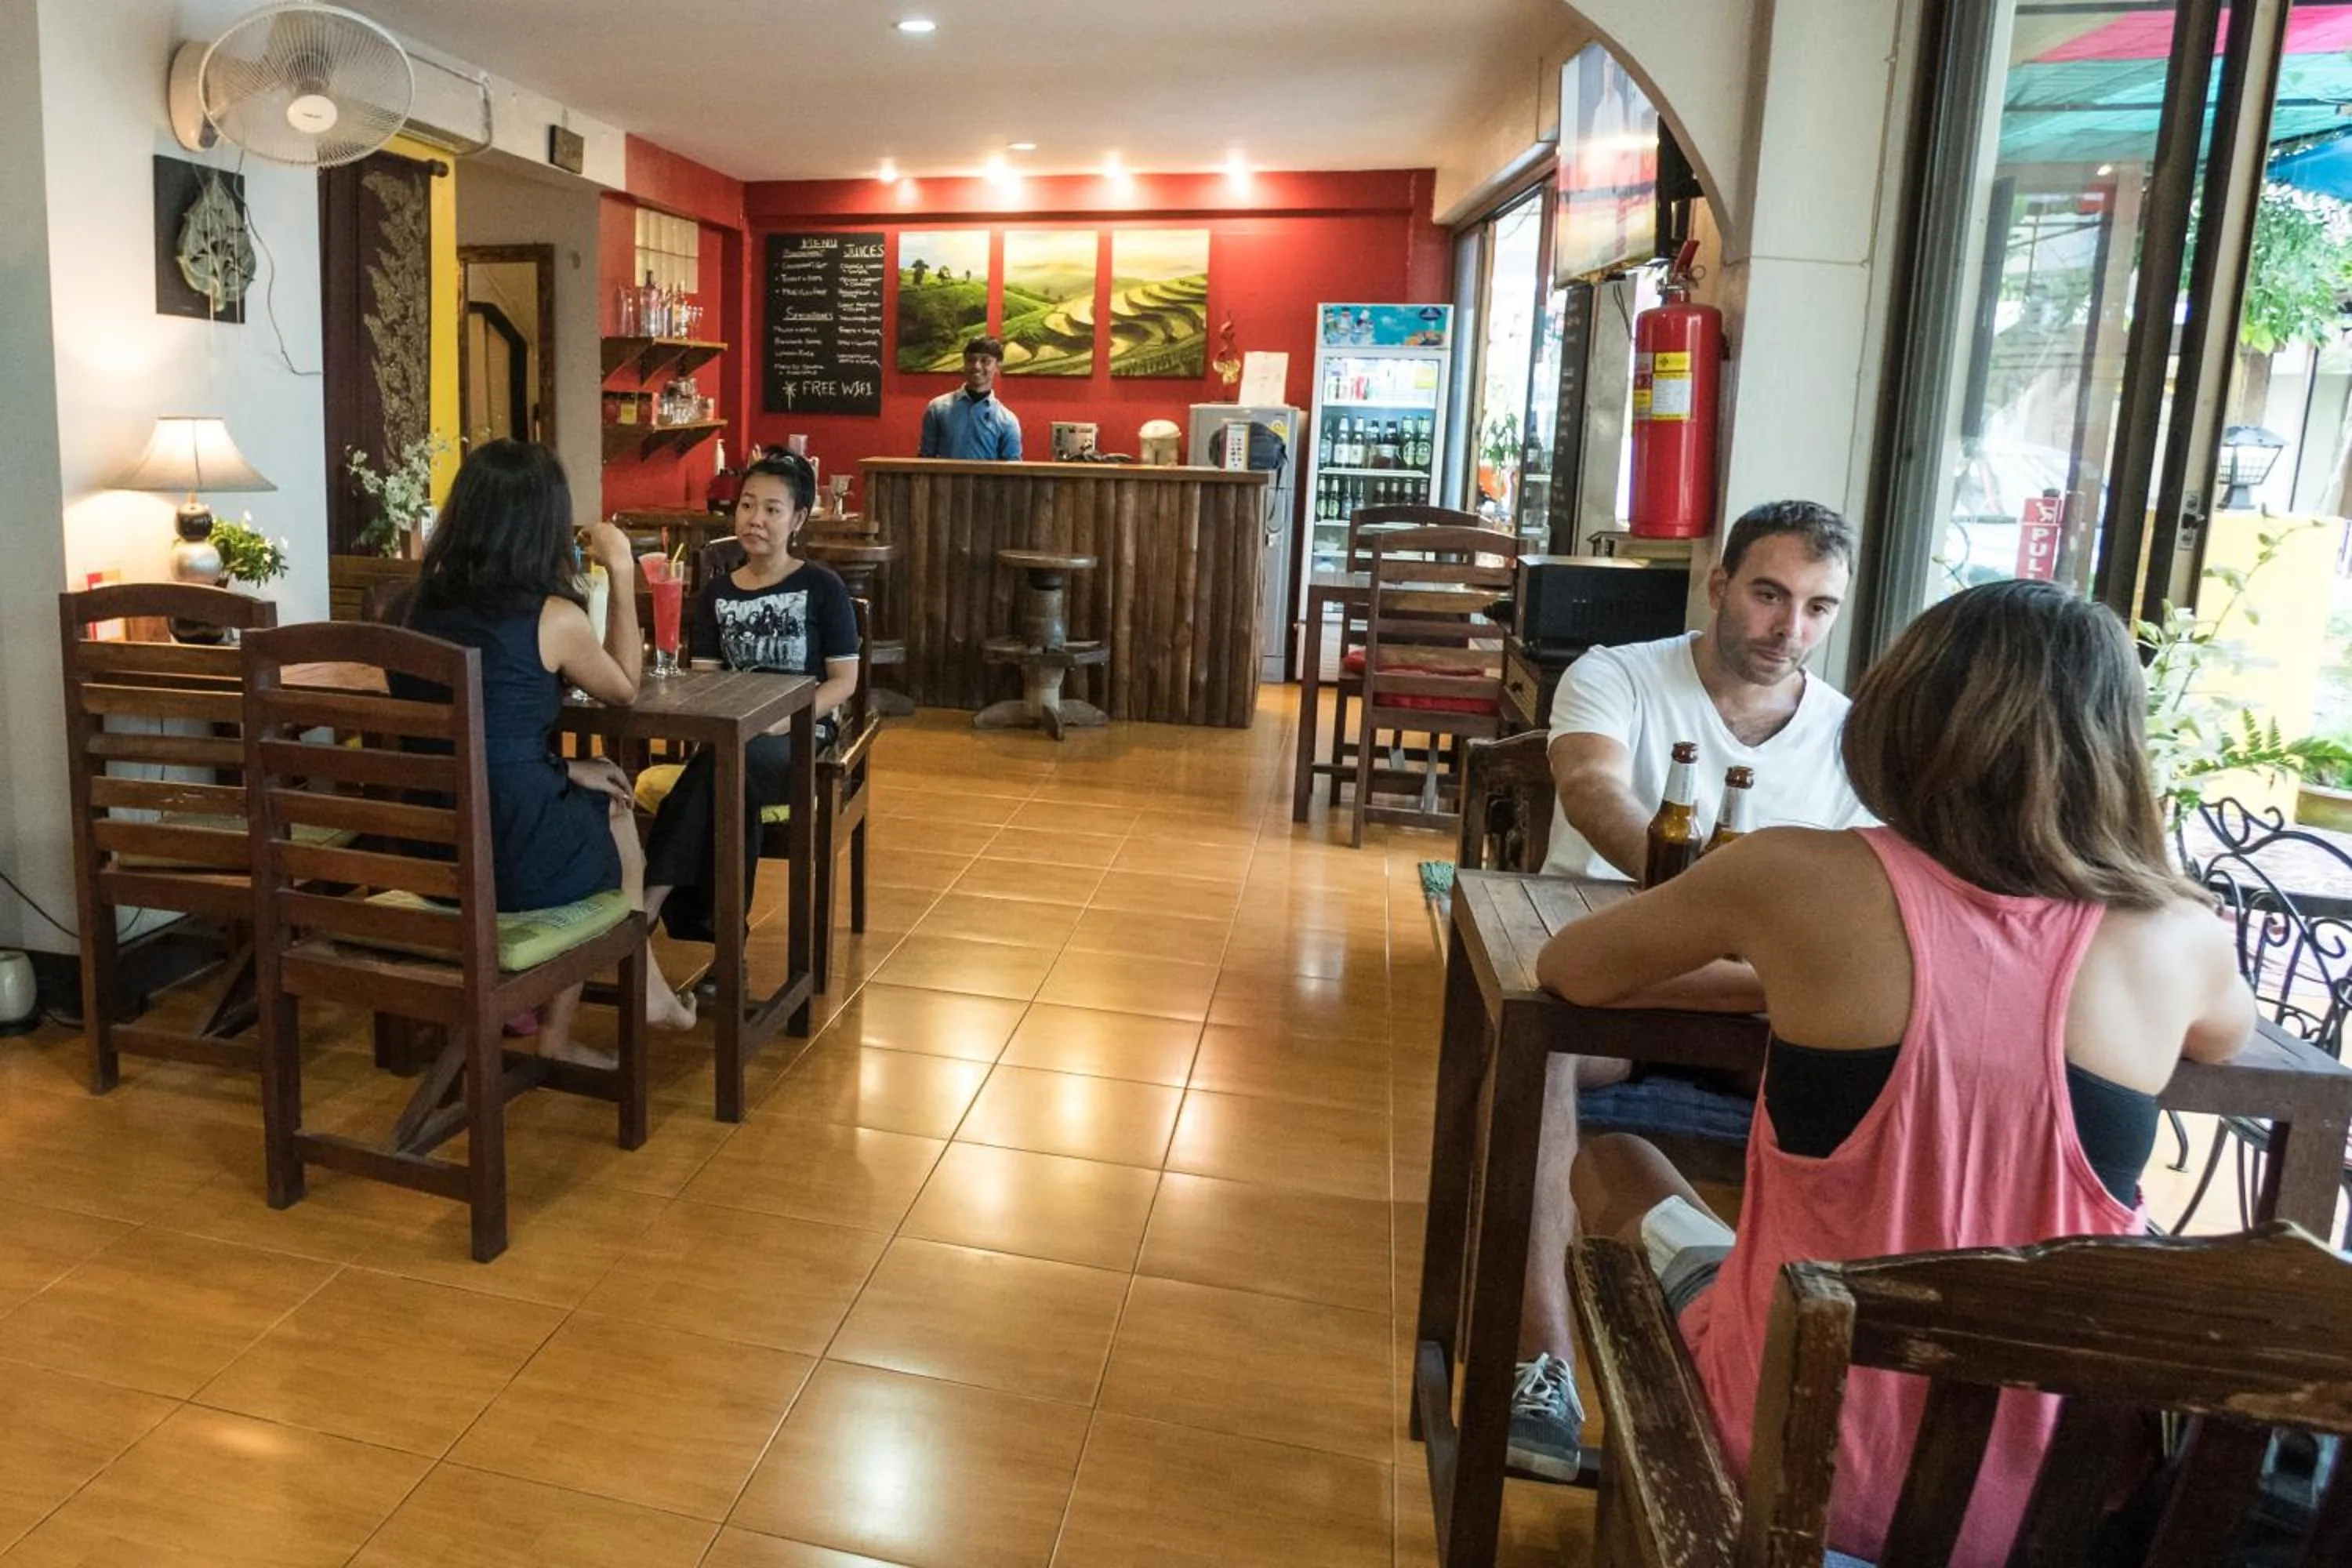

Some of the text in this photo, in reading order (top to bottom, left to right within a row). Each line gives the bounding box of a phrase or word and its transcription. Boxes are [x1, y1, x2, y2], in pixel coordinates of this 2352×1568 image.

[801, 238, 838, 249] MENU
[843, 244, 884, 257] JUICES
[802, 380, 837, 397] FREE
